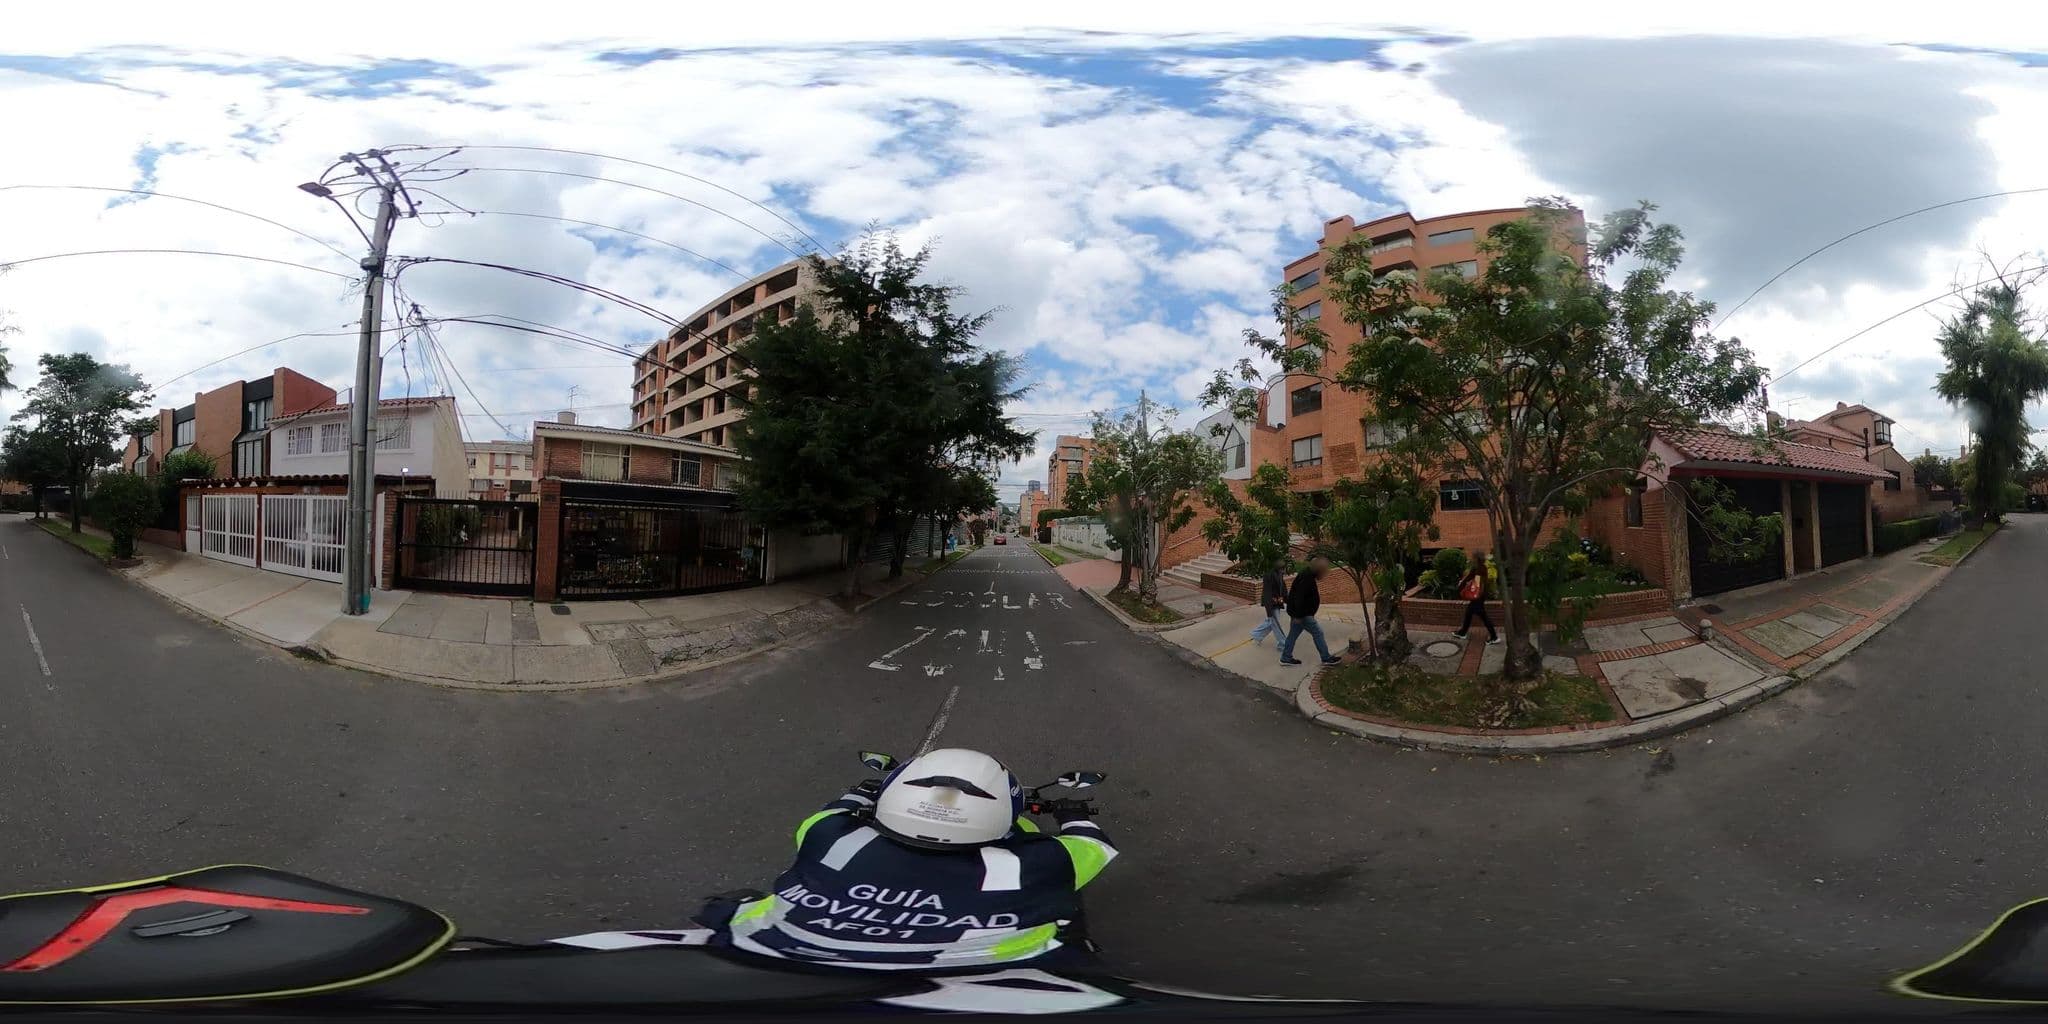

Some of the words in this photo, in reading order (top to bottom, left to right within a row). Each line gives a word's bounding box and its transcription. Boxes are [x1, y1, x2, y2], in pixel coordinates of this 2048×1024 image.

[899, 589, 1073, 609] SCOLAR
[779, 884, 1020, 929] MOVILIDAD
[848, 884, 944, 910] GUÍA
[807, 918, 916, 939] AF01
